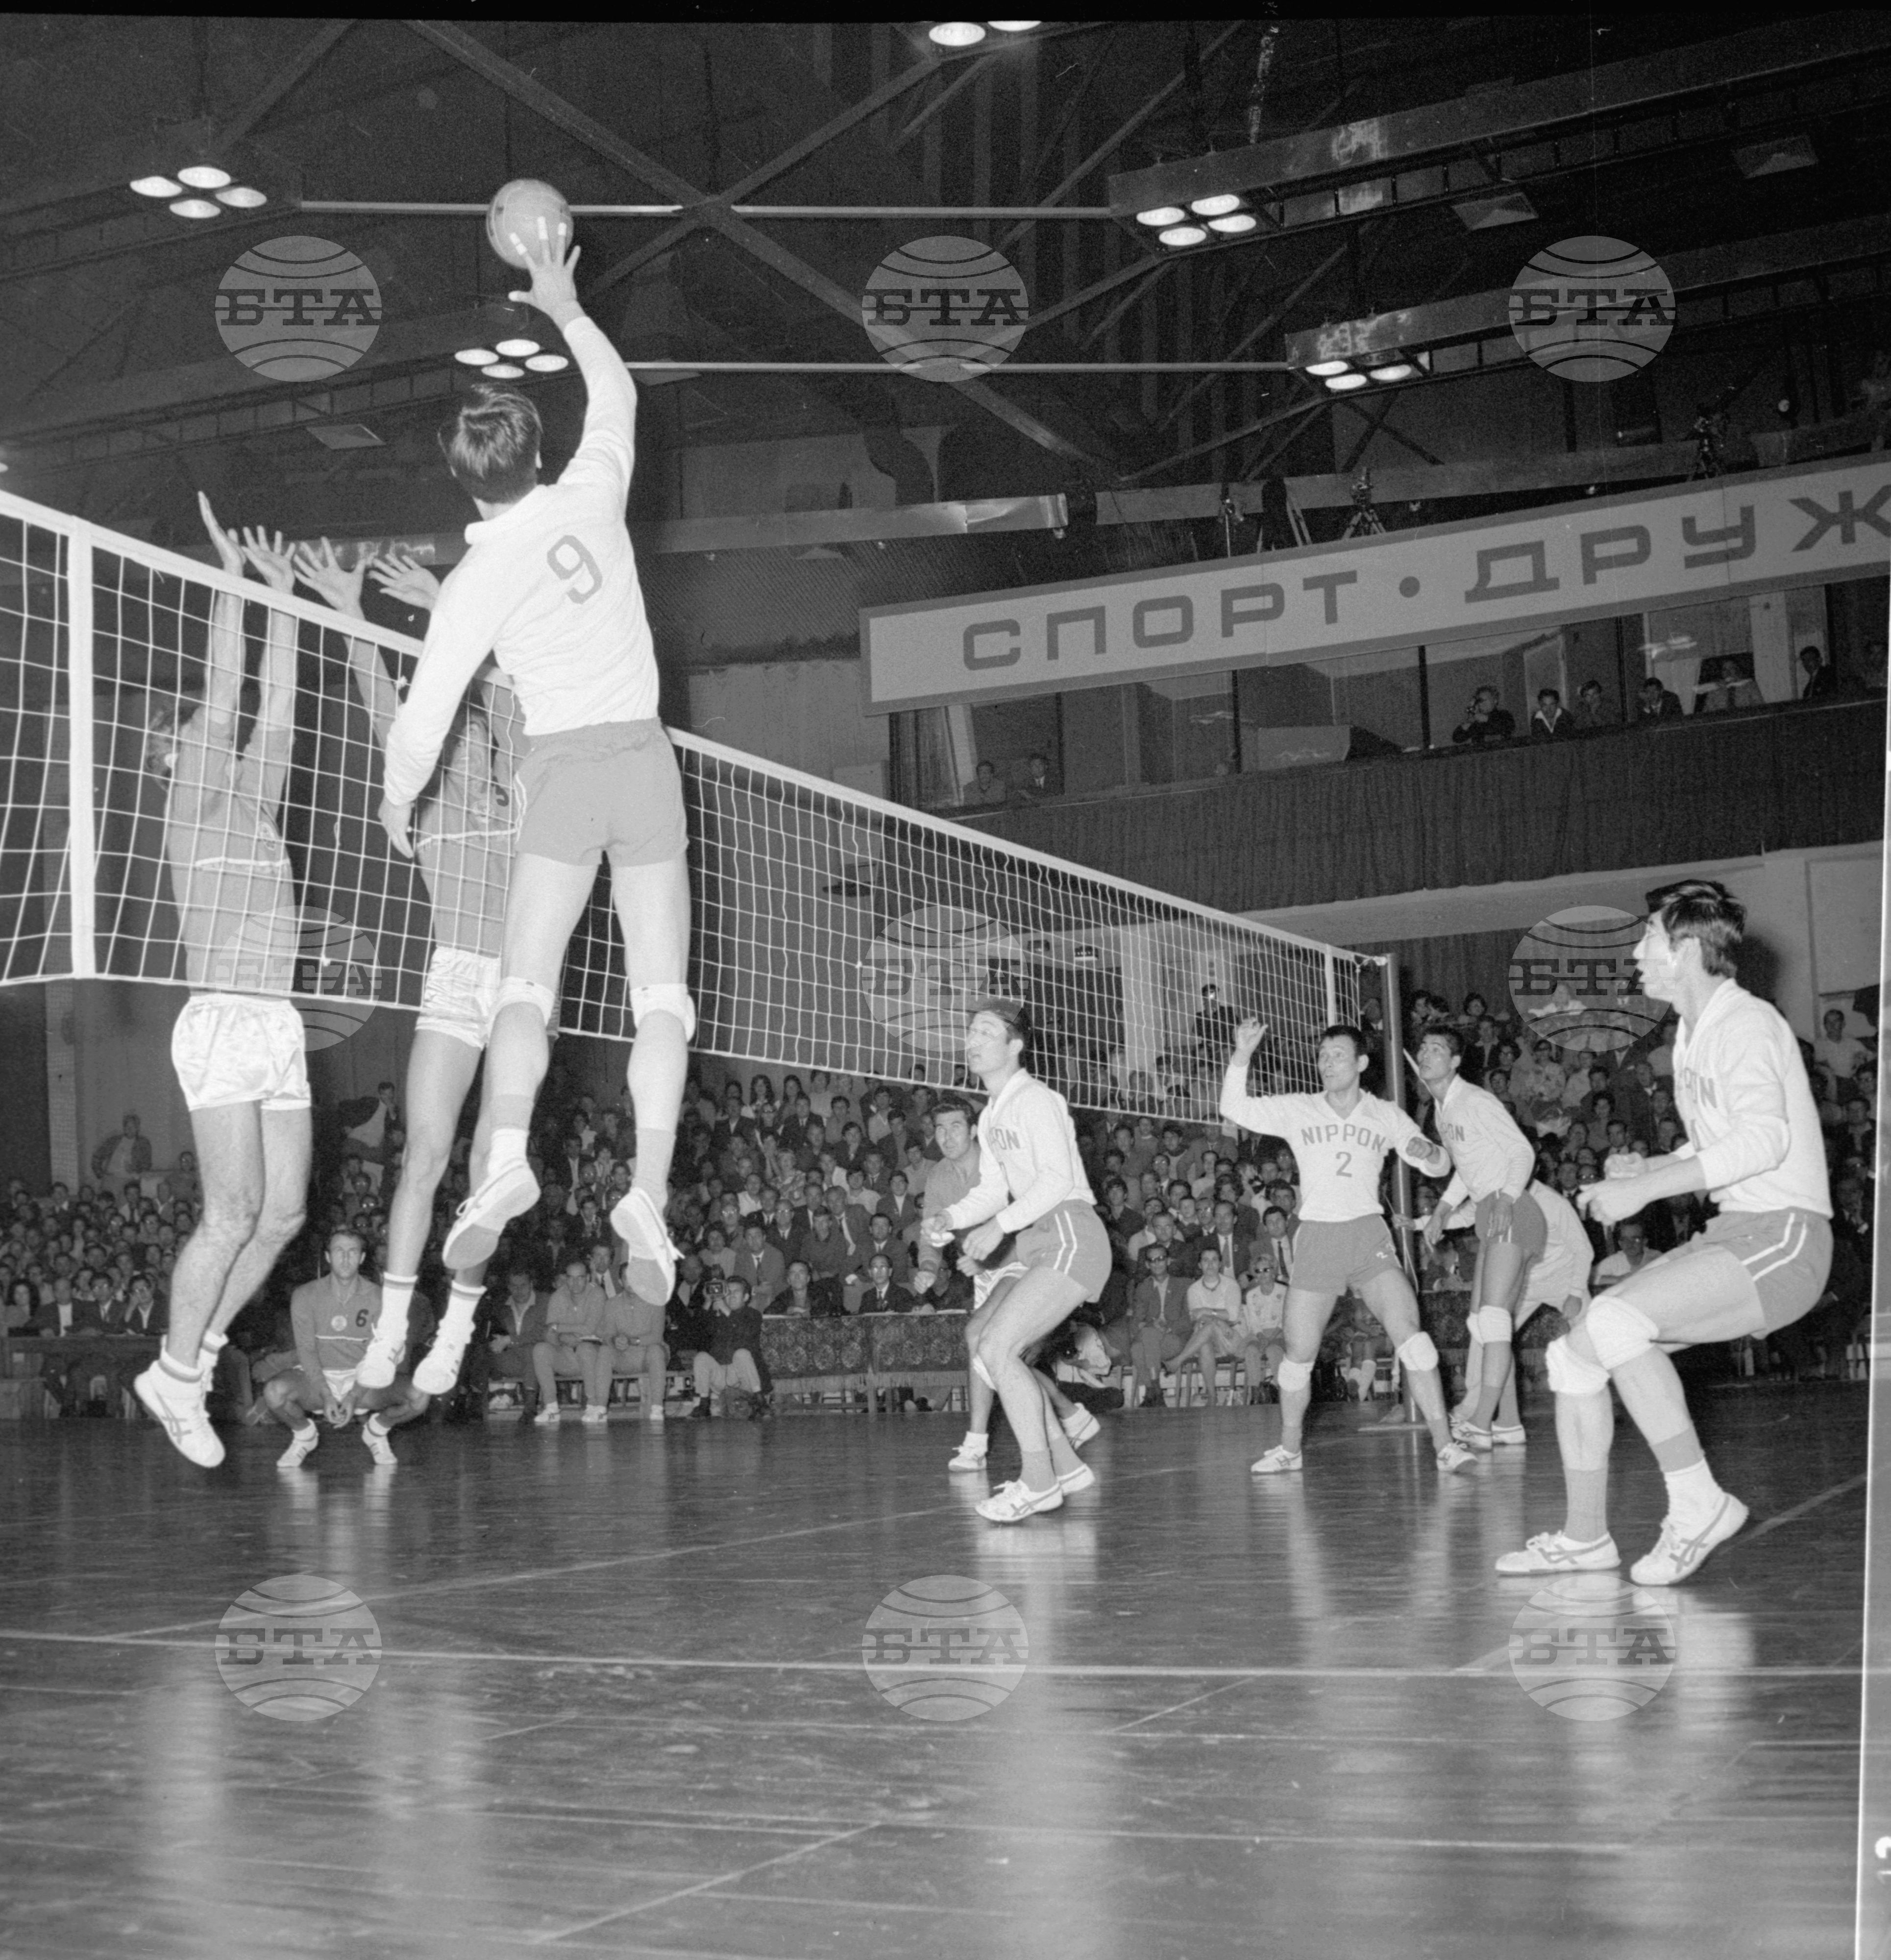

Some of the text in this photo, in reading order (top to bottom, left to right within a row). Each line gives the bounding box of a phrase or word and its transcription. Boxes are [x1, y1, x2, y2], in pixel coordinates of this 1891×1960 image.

[547, 535, 602, 604] 9
[963, 485, 1891, 670] СПОРТ ДРУЖ
[1301, 1124, 1386, 1152] NIPPON
[1336, 1152, 1352, 1177] 2
[356, 1309, 369, 1327] 6
